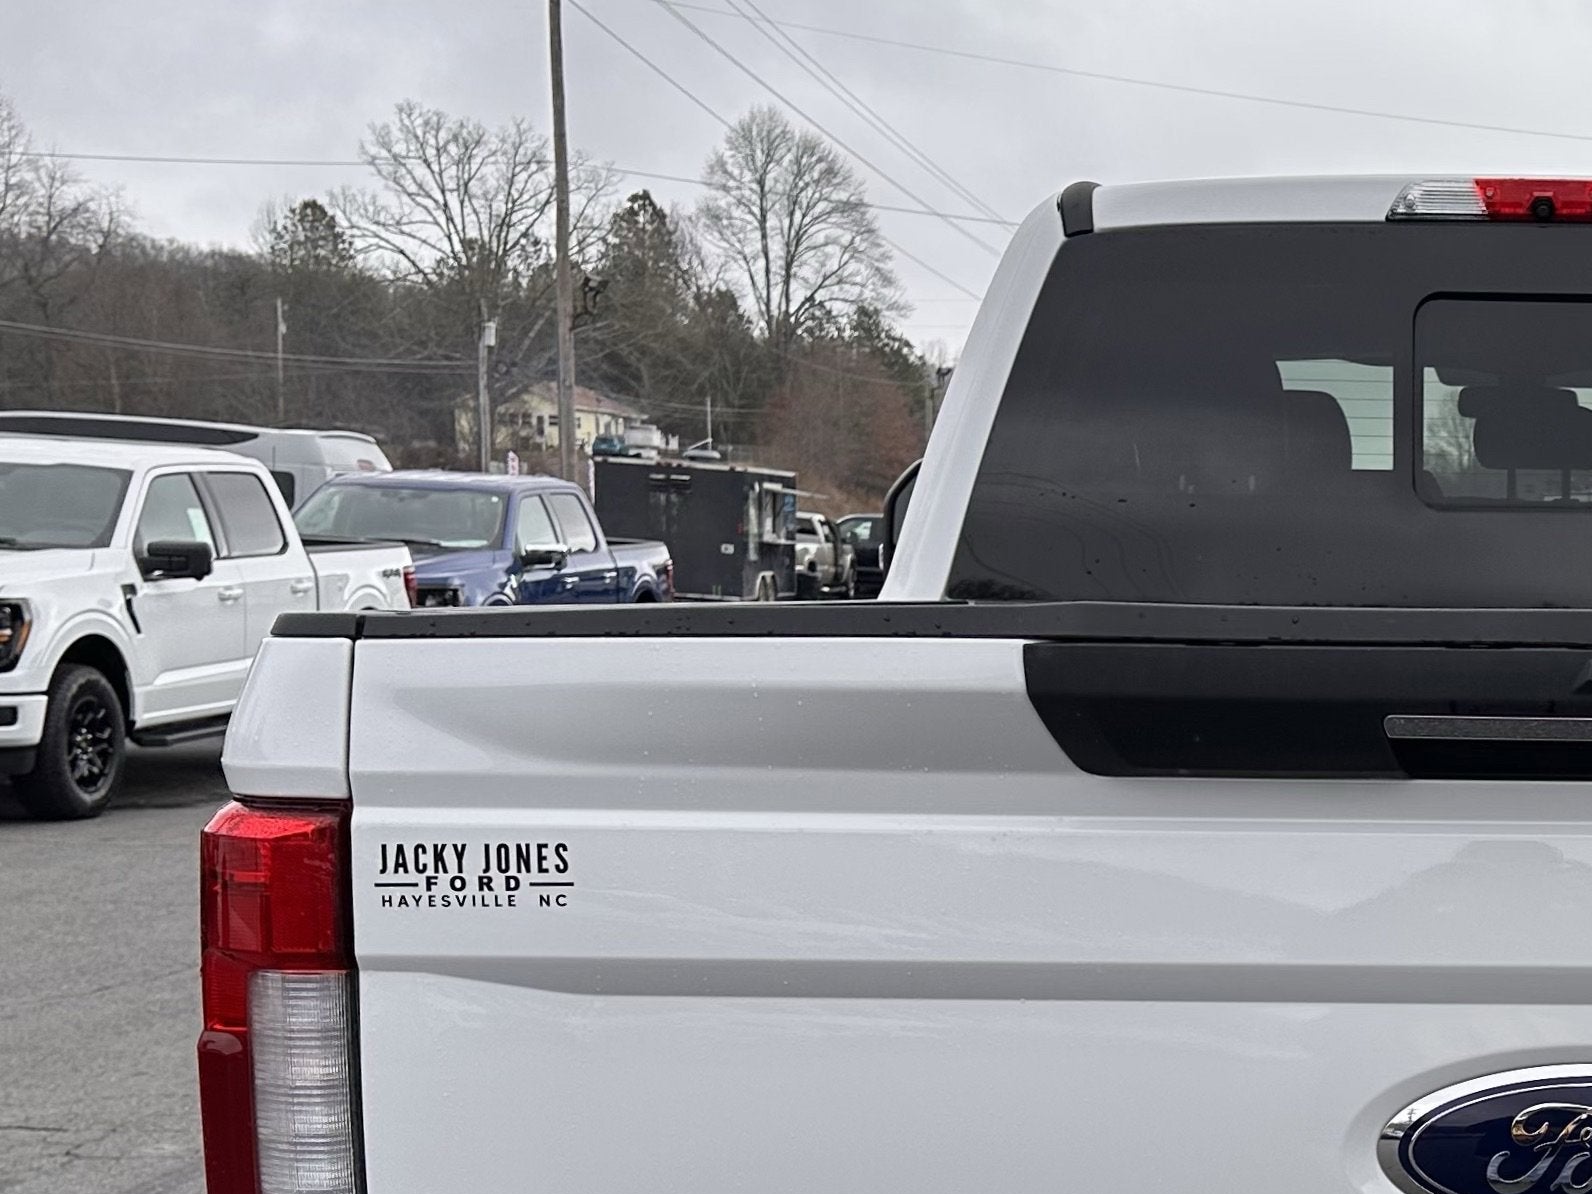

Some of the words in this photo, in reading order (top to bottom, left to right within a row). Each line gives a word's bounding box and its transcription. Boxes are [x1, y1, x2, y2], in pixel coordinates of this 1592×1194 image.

[379, 843, 467, 874] JACKY
[482, 842, 569, 874] JONES
[425, 875, 521, 892] FORD
[381, 894, 517, 908] HAYESVILLE
[539, 894, 568, 907] NC
